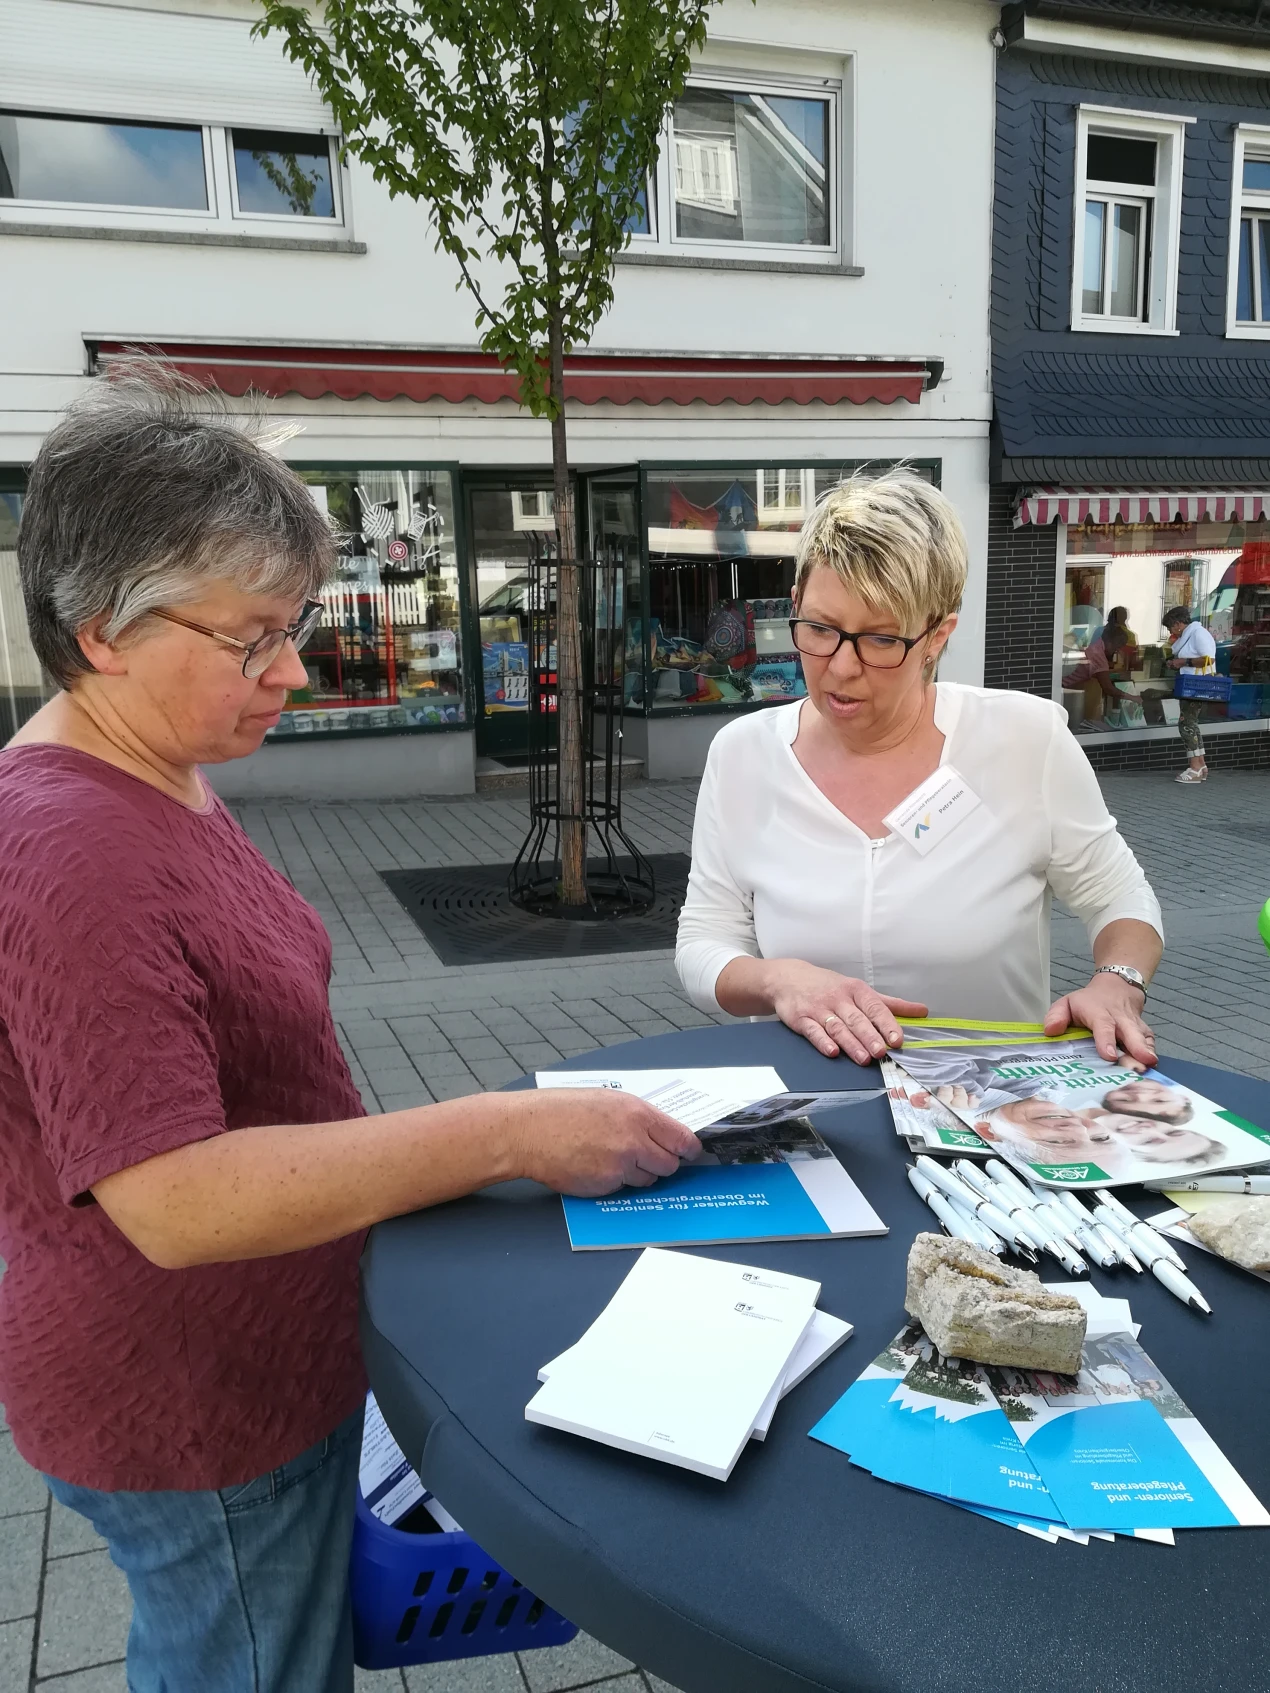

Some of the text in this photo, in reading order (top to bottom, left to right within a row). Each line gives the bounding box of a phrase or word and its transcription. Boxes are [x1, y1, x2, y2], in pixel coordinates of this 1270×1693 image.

[918, 802, 926, 812] und
[938, 790, 964, 814] Petra Hein
[1057, 1053, 1085, 1061] zum
[988, 1061, 1095, 1080] Schritt
[1038, 1072, 1144, 1090] Schritt für
[1043, 1168, 1089, 1180] AOK
[595, 1192, 766, 1207] im Oberbergischen Kreis
[600, 1199, 770, 1214] Wegweiser für Senioren
[999, 1465, 1042, 1482] ratung
[1007, 1479, 1034, 1491] und
[1090, 1480, 1187, 1492] Pflegeberatung
[1106, 1491, 1194, 1504] Senioren- und
